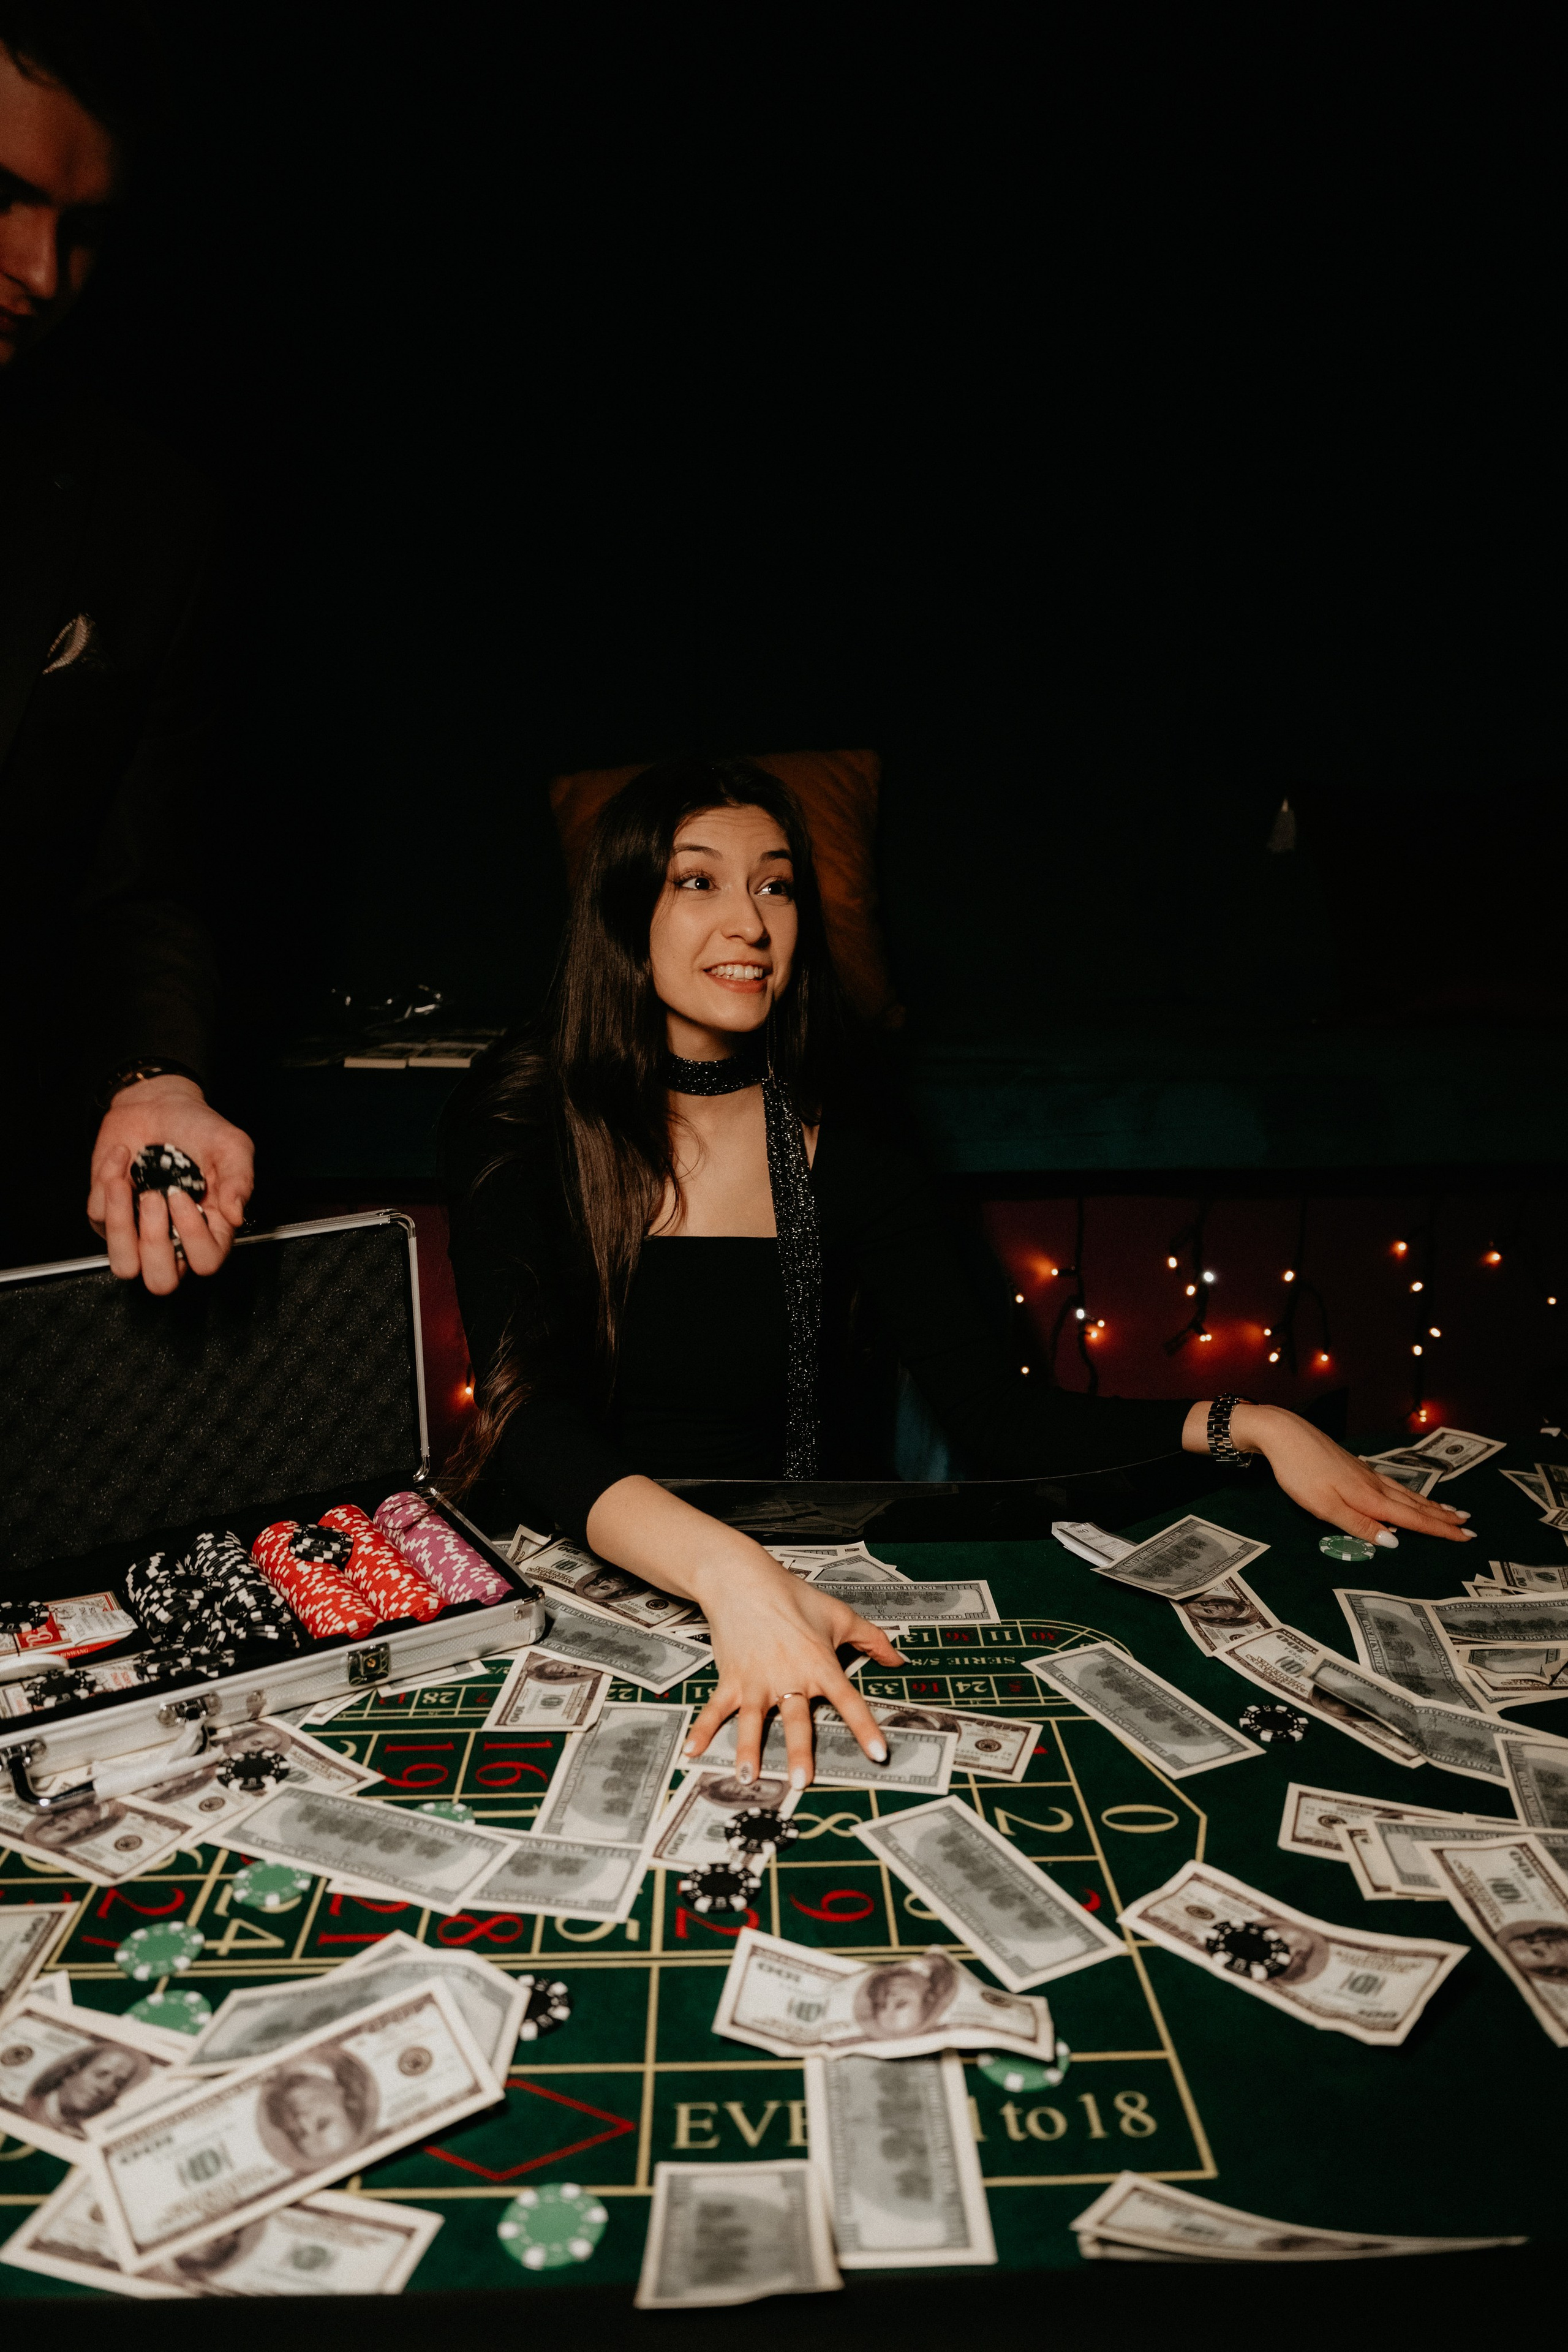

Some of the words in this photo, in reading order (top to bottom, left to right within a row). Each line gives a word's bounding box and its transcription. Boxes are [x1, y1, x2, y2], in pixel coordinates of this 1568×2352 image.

[988, 1630, 1012, 1642] 11
[1276, 1635, 1305, 1653] 100
[946, 1656, 1016, 1665] SERIE
[868, 1683, 899, 1695] 33
[956, 1681, 988, 1693] 24
[423, 1691, 456, 1705] 28
[377, 1741, 454, 1789] 19
[475, 1738, 552, 1787] 16
[1101, 1804, 1179, 1834] 0
[671, 2099, 809, 2150] EVE
[998, 2100, 1064, 2142] to
[1075, 2089, 1158, 2139] 18
